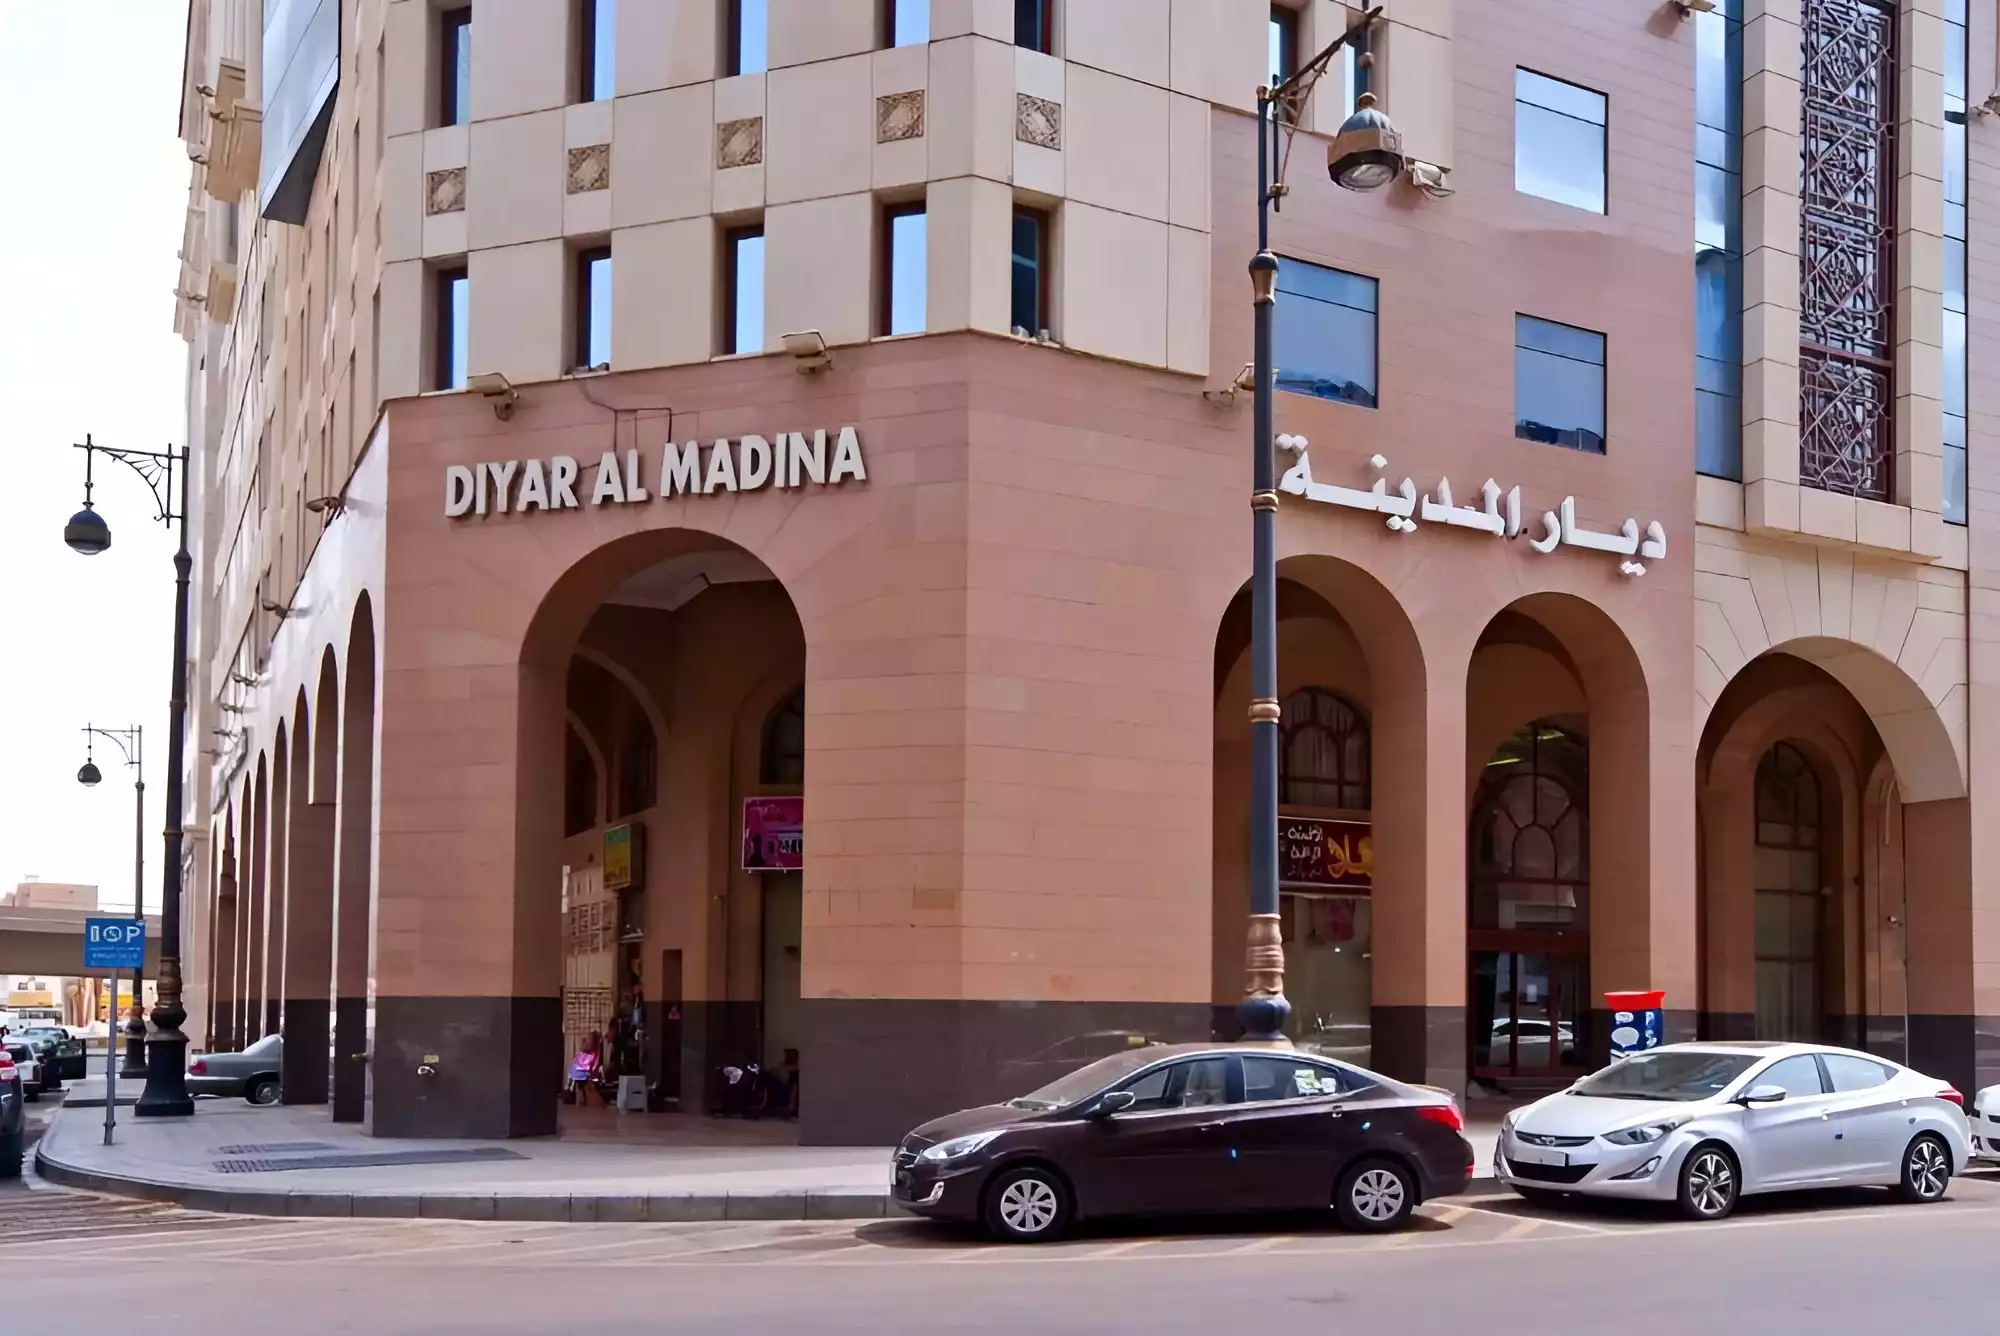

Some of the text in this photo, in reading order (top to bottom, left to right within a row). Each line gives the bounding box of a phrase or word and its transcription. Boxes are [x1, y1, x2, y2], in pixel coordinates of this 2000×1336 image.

[445, 426, 867, 517] DIYAR AL MADINA
[1275, 432, 1667, 577] ديار المدينة
